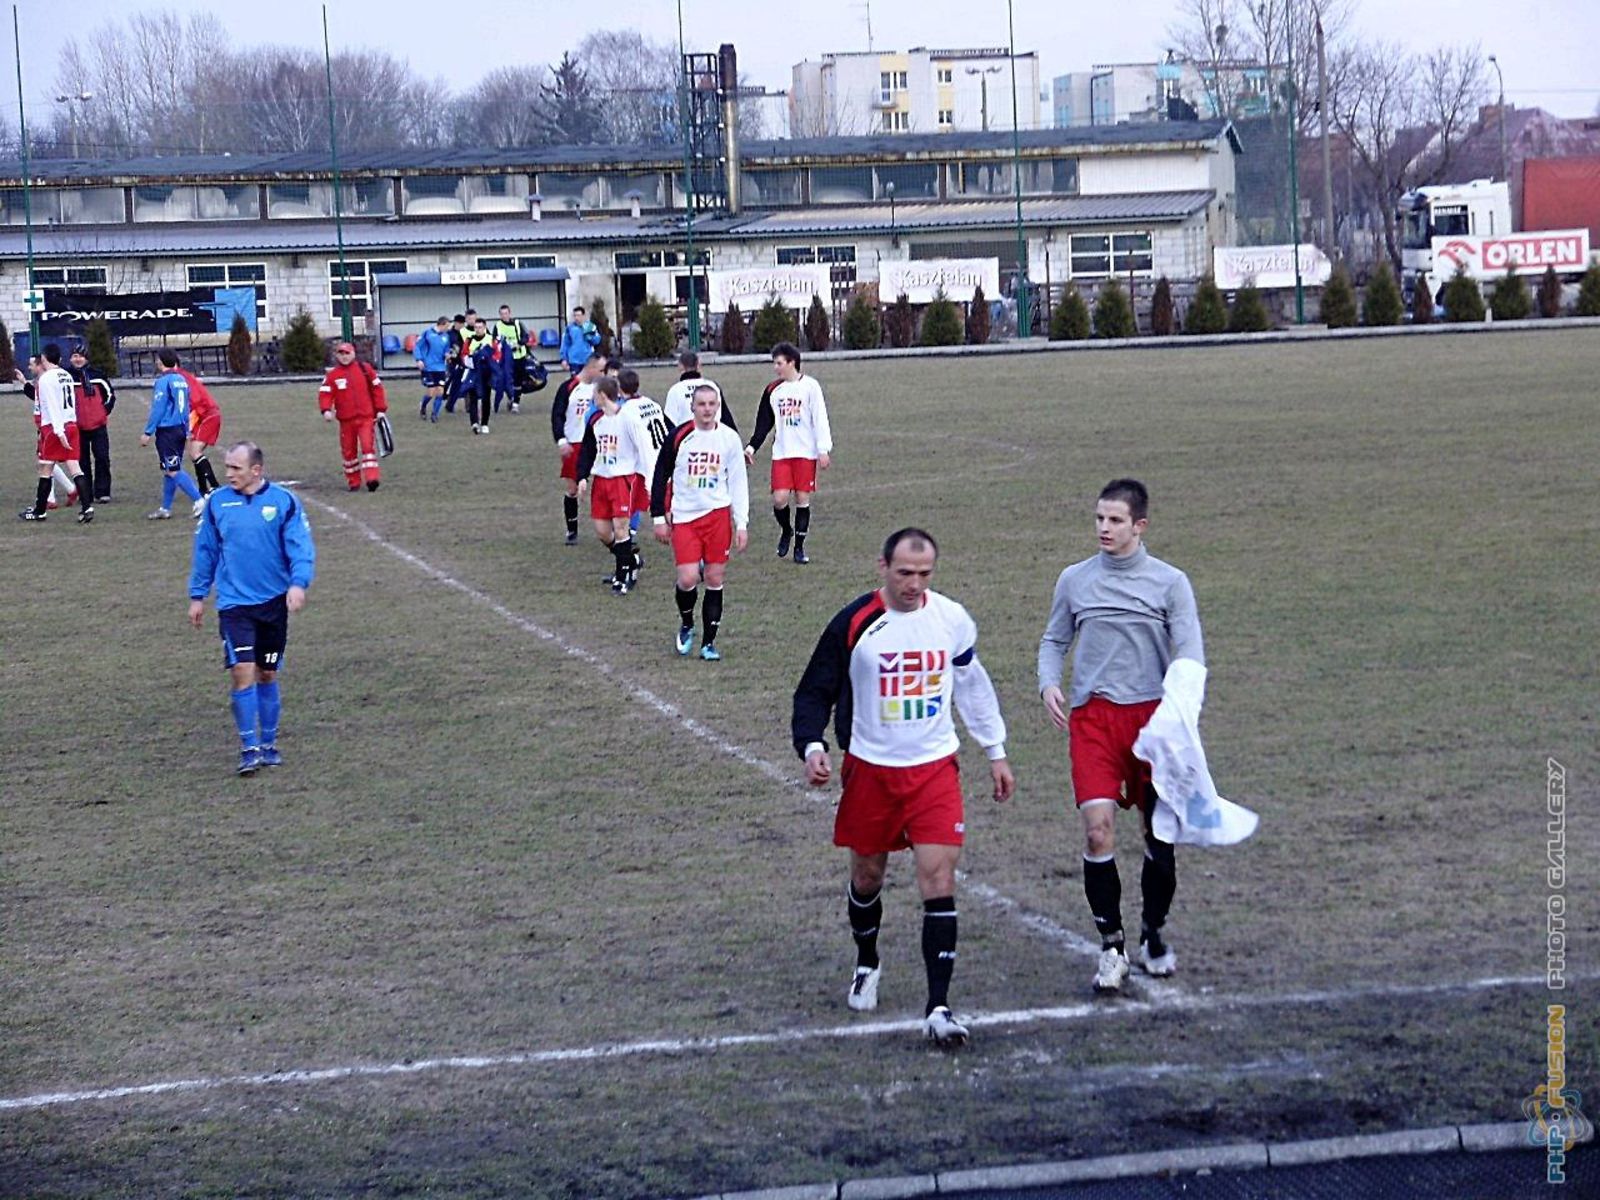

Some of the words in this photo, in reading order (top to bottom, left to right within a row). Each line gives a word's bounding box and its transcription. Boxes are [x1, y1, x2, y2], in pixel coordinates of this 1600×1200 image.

[1486, 239, 1576, 266] ORLEN
[729, 273, 815, 294] Kasztelan
[899, 267, 982, 288] Kasztelan
[647, 418, 666, 449] 10
[264, 652, 278, 663] 18
